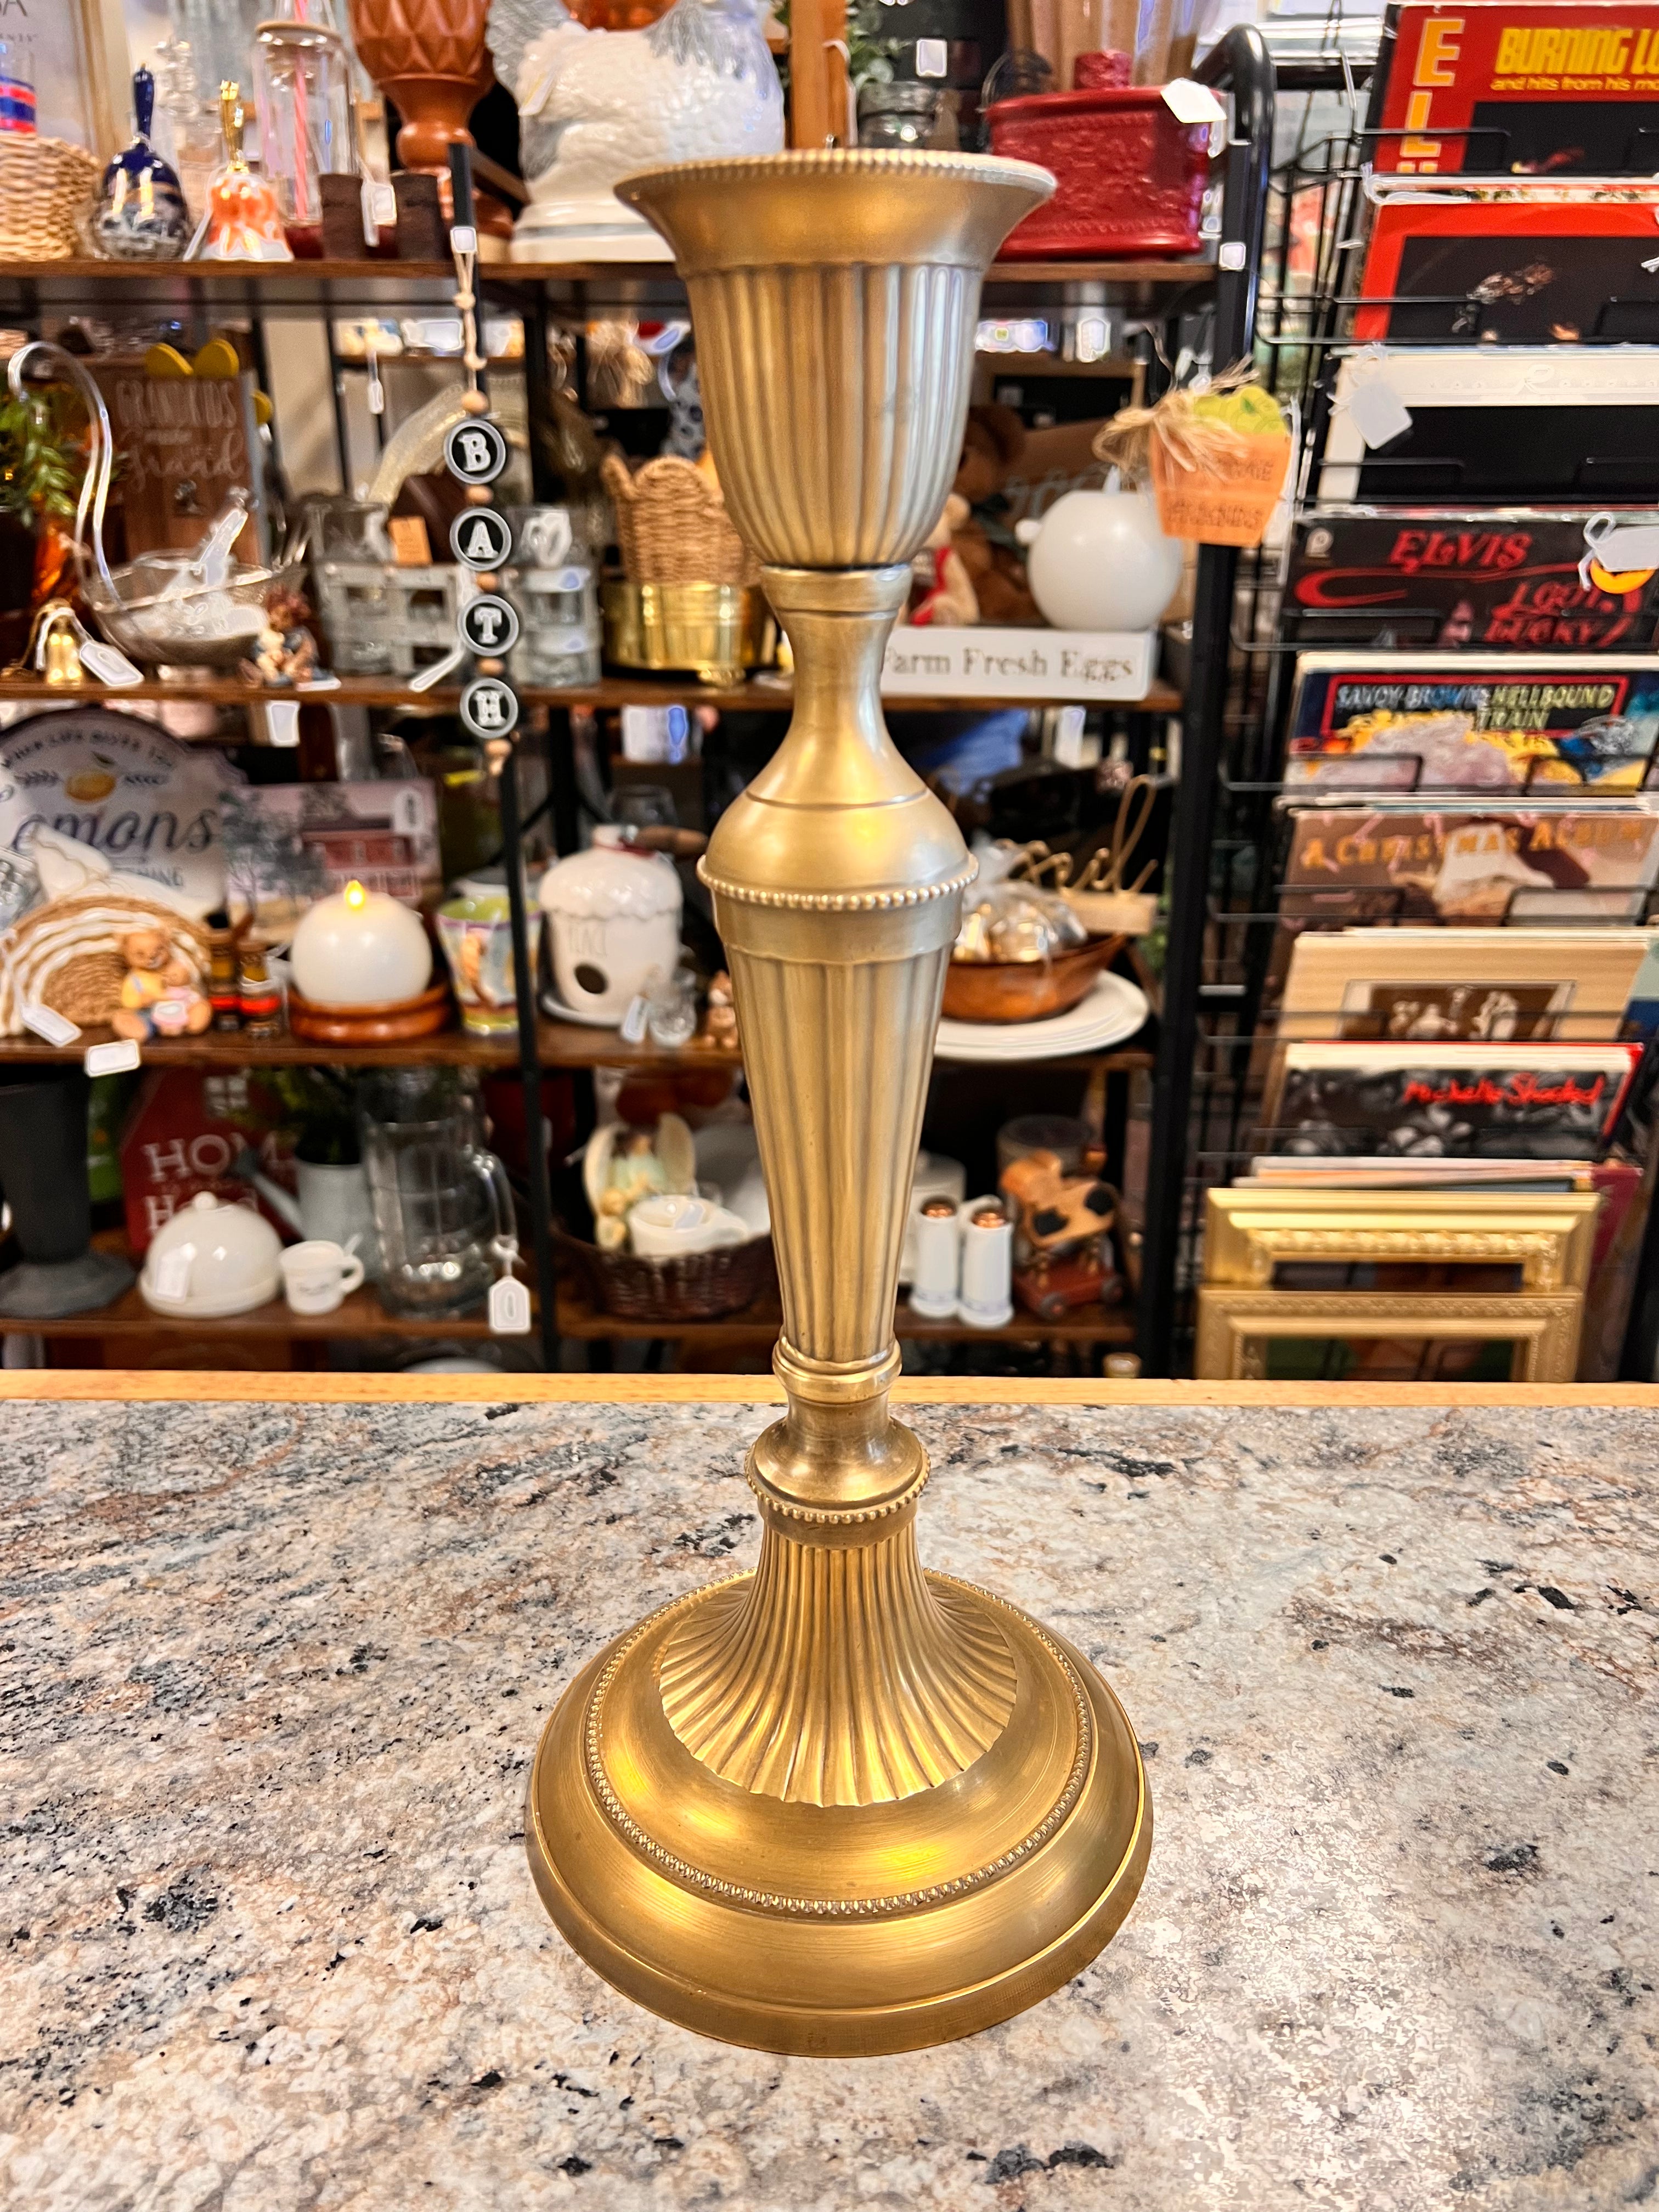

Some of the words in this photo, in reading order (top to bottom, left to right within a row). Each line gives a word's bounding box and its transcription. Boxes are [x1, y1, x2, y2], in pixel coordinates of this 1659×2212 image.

[1494, 28, 1633, 75] BURNING
[1396, 18, 1466, 173] EL
[1490, 76, 1527, 91] and
[1561, 76, 1603, 91] from
[1604, 76, 1631, 91] his
[1389, 529, 1532, 574] ELVIS
[962, 647, 1048, 676] Fresh
[1060, 649, 1134, 684] Eggs
[1335, 685, 1404, 709] SAVOY
[1492, 685, 1615, 709] HELLBOUND
[1477, 709, 1551, 732] TRAIN
[12, 809, 219, 853] emons
